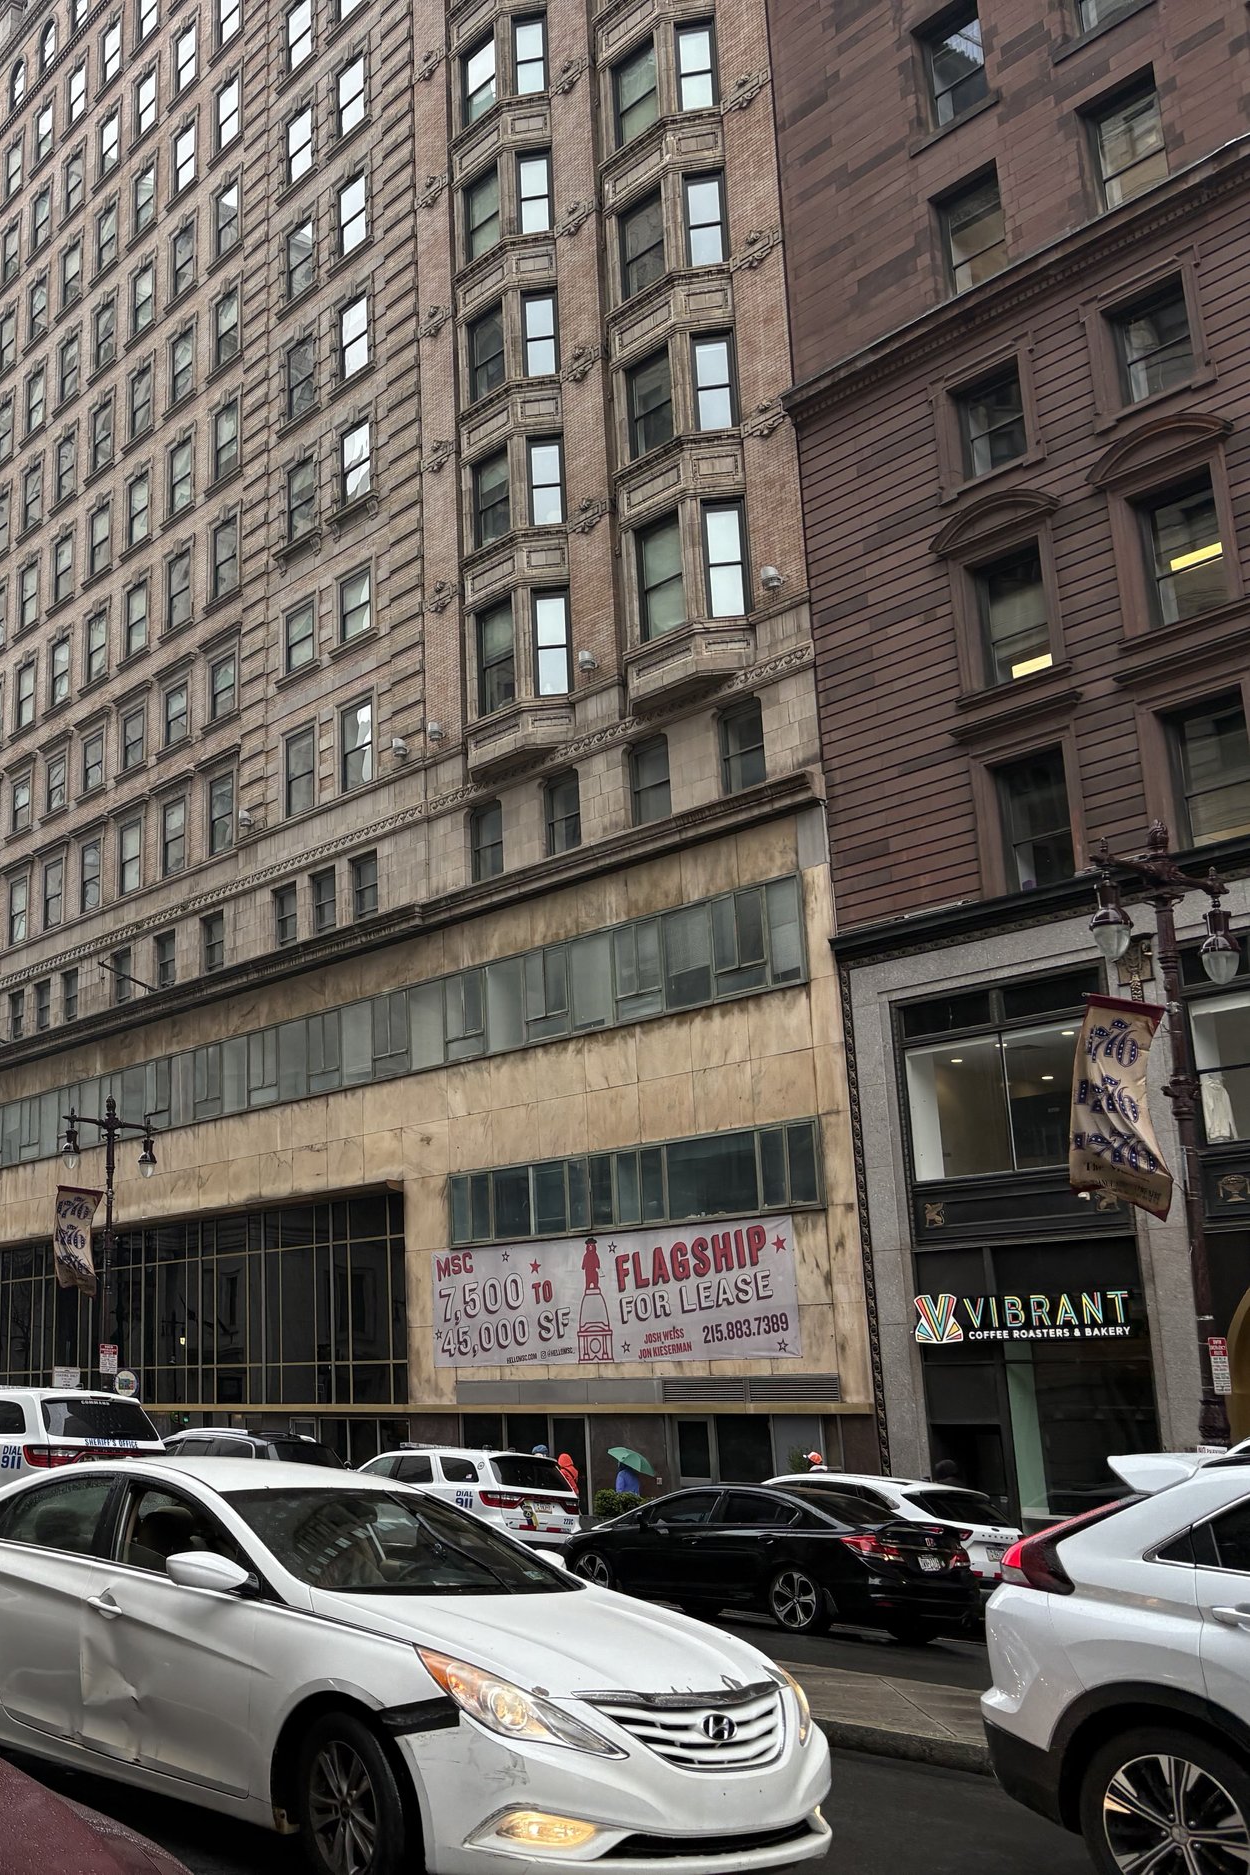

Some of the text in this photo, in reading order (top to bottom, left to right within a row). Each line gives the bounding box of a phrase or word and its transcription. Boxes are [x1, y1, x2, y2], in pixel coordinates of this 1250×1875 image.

[436, 1252, 474, 1282] MSC
[615, 1225, 767, 1292] FLAGSHIP
[439, 1272, 553, 1325] 7,500 TO
[619, 1269, 774, 1324] FOR LEASE
[963, 1290, 1129, 1329] VIBRANT
[442, 1307, 571, 1358] 45,000 SF
[644, 1328, 685, 1344] JOSH WEISS
[702, 1312, 789, 1343] 215.883.7389
[968, 1326, 1131, 1340] COFFEE ROASTERS & BAKERY
[638, 1341, 693, 1359] JON KIESERMAN
[2, 1445, 22, 1456] DIAL
[84, 1438, 139, 1449] SHERIFF'S OFFICE
[1, 1455, 22, 1469] 911
[455, 1490, 474, 1498] DIAL
[455, 1497, 473, 1509] 911
